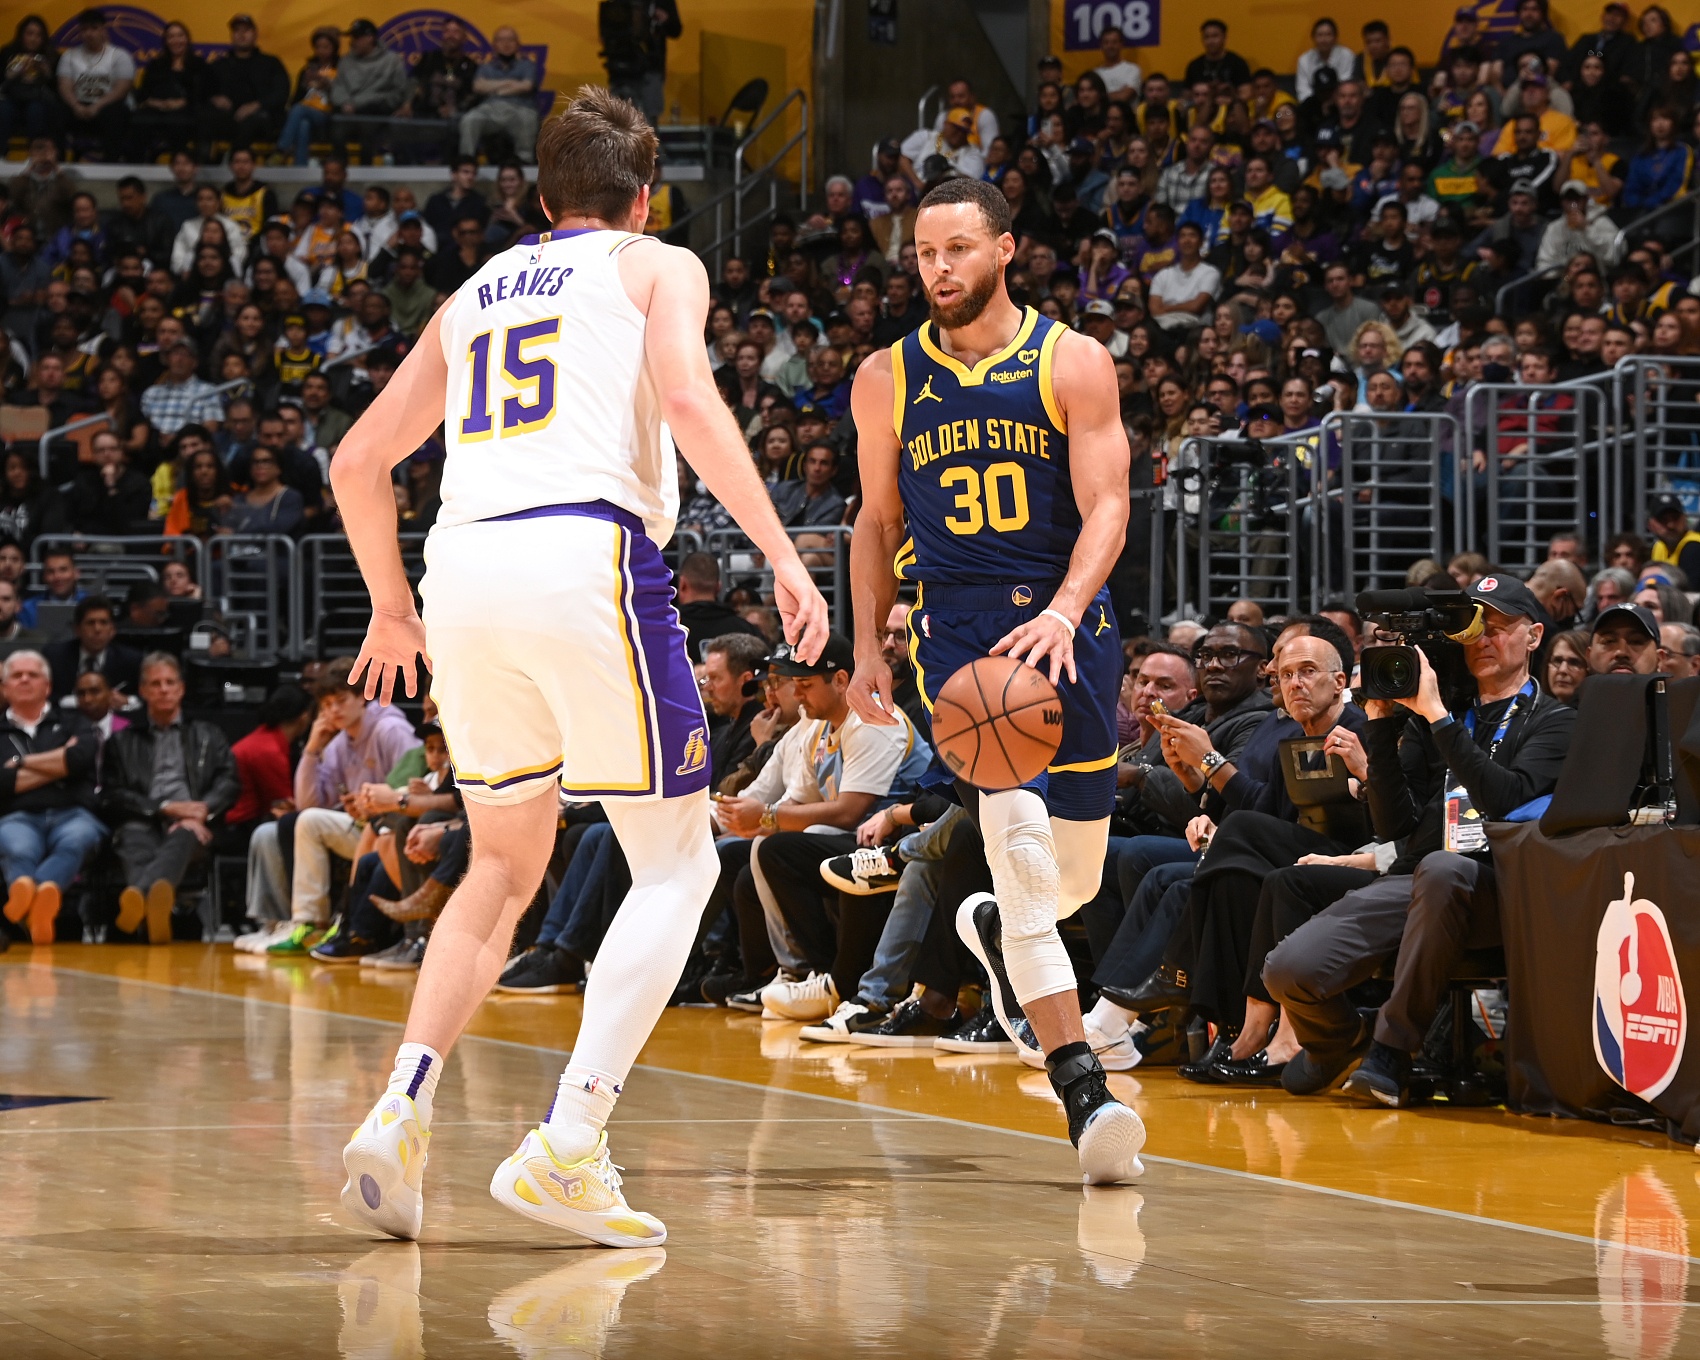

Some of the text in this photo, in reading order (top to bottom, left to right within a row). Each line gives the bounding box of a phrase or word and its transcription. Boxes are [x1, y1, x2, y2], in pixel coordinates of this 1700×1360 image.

[1072, 1, 1150, 42] 108
[477, 267, 574, 310] REAVES
[458, 315, 563, 443] 15
[990, 369, 1033, 383] Rakuten
[907, 418, 1051, 471] GOLDEN STATE
[940, 462, 1030, 535] 30
[1656, 974, 1678, 1015] NBA
[1624, 1012, 1679, 1047] ESPN
